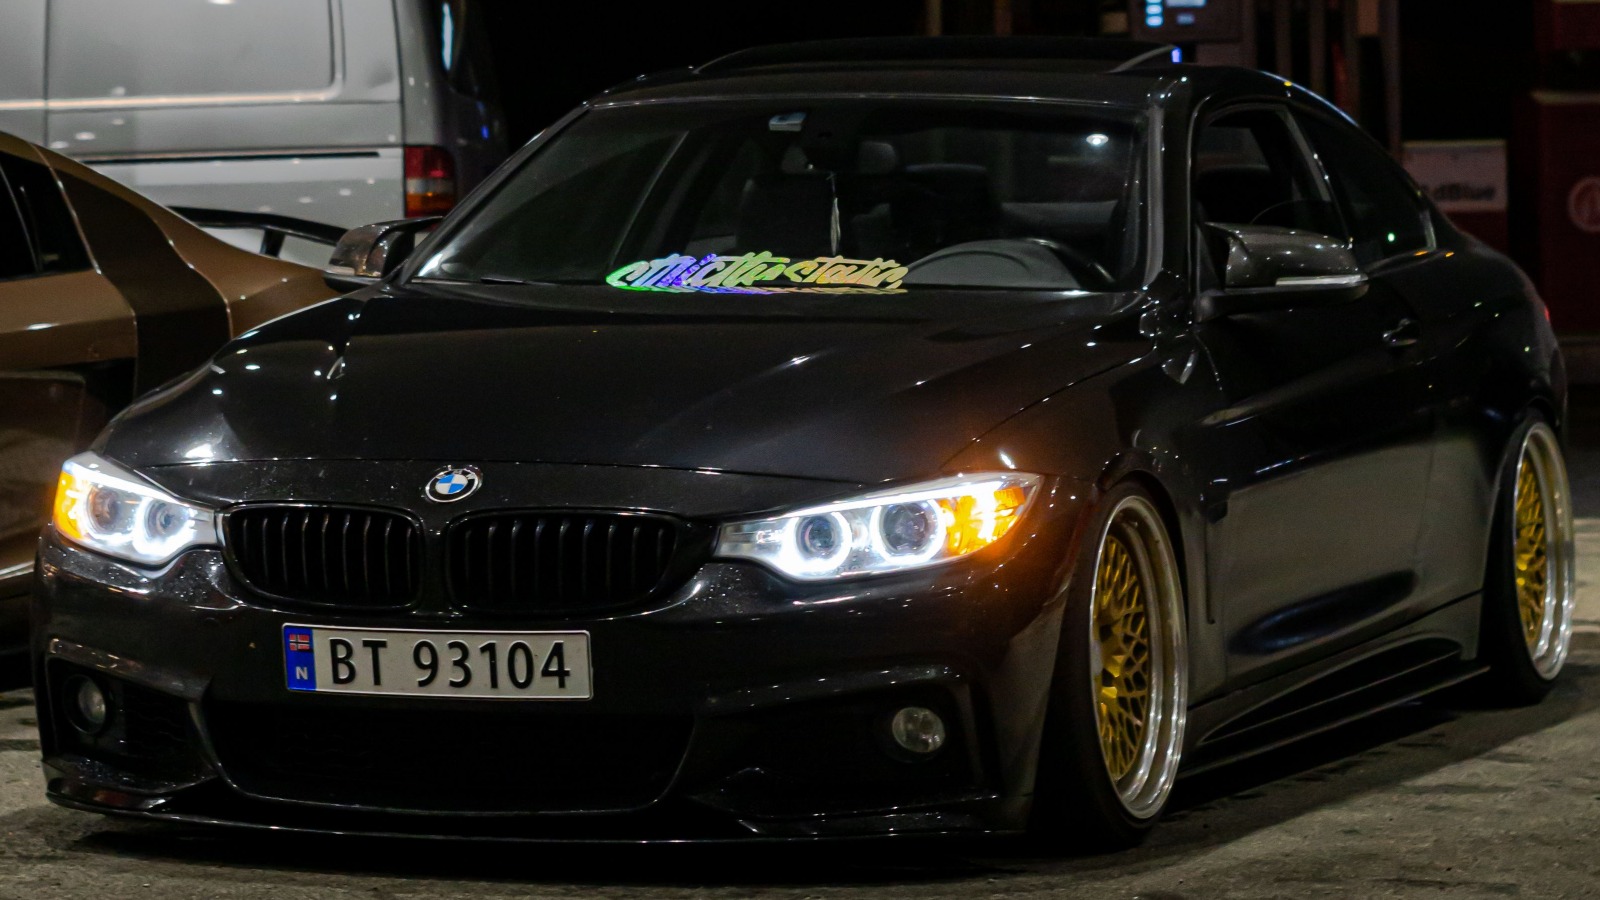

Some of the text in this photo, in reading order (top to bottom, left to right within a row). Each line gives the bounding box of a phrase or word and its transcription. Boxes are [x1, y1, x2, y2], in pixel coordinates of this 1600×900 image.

[295, 665, 309, 681] N
[328, 637, 571, 689] BT 93104
